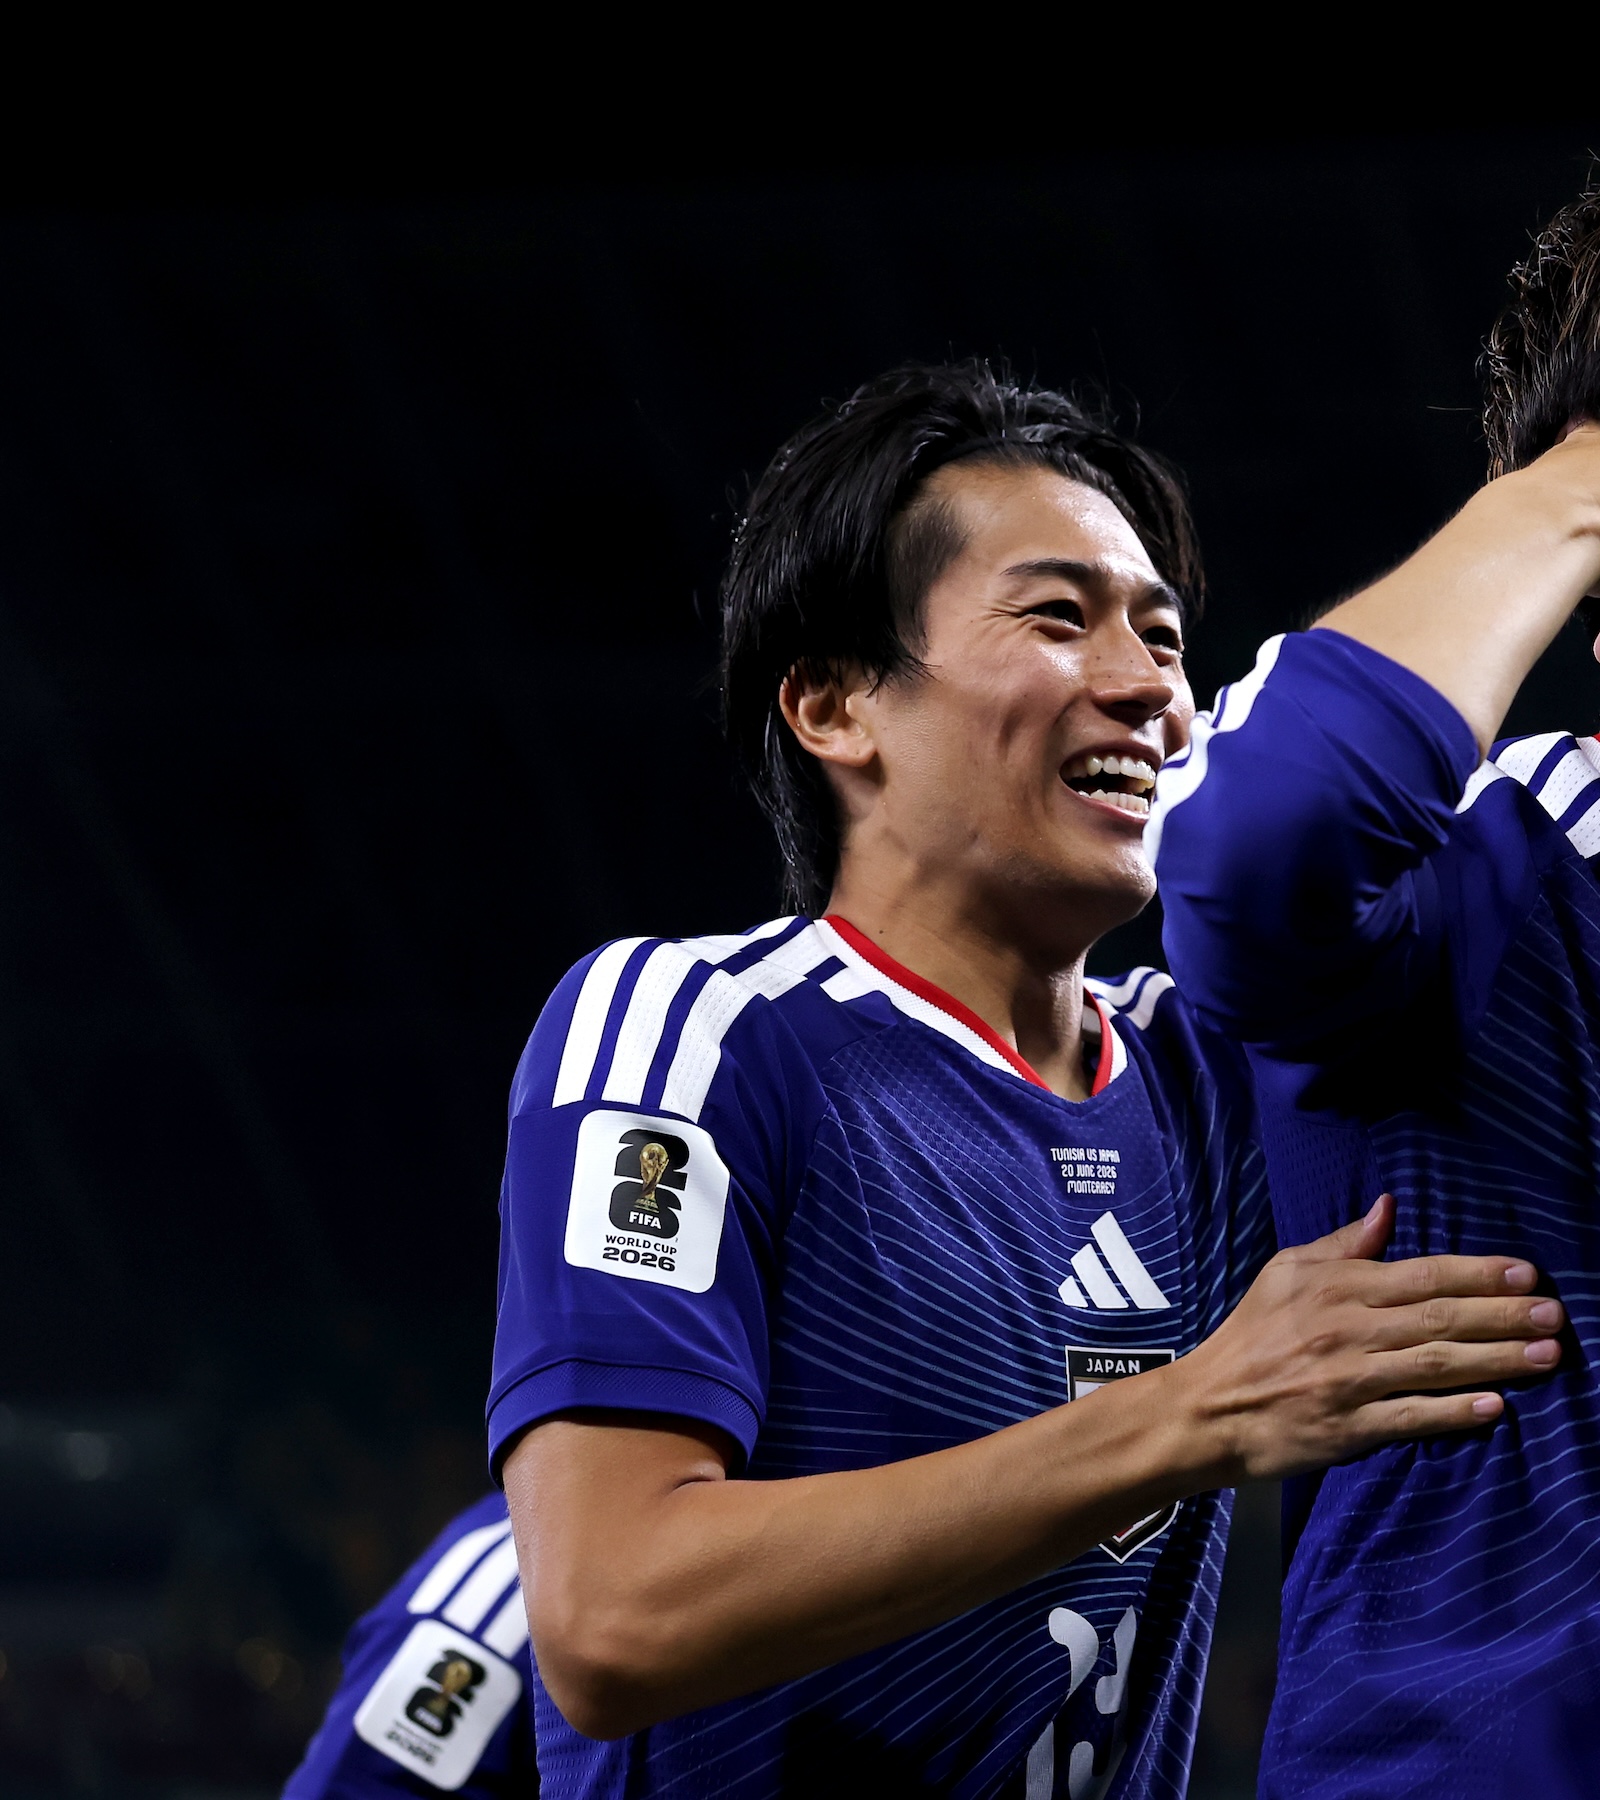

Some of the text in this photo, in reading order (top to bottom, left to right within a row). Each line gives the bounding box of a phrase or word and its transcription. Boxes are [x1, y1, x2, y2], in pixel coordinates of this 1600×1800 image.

[1050, 1148, 1085, 1161] TUNISIA
[1061, 1164, 1117, 1178] 20 JUNE 2026
[1067, 1180, 1115, 1194] MONTERREY
[628, 1211, 662, 1229] FIFA
[605, 1234, 677, 1255] WORLD CUP
[602, 1247, 676, 1272] 2026
[1086, 1358, 1140, 1374] JAPAN
